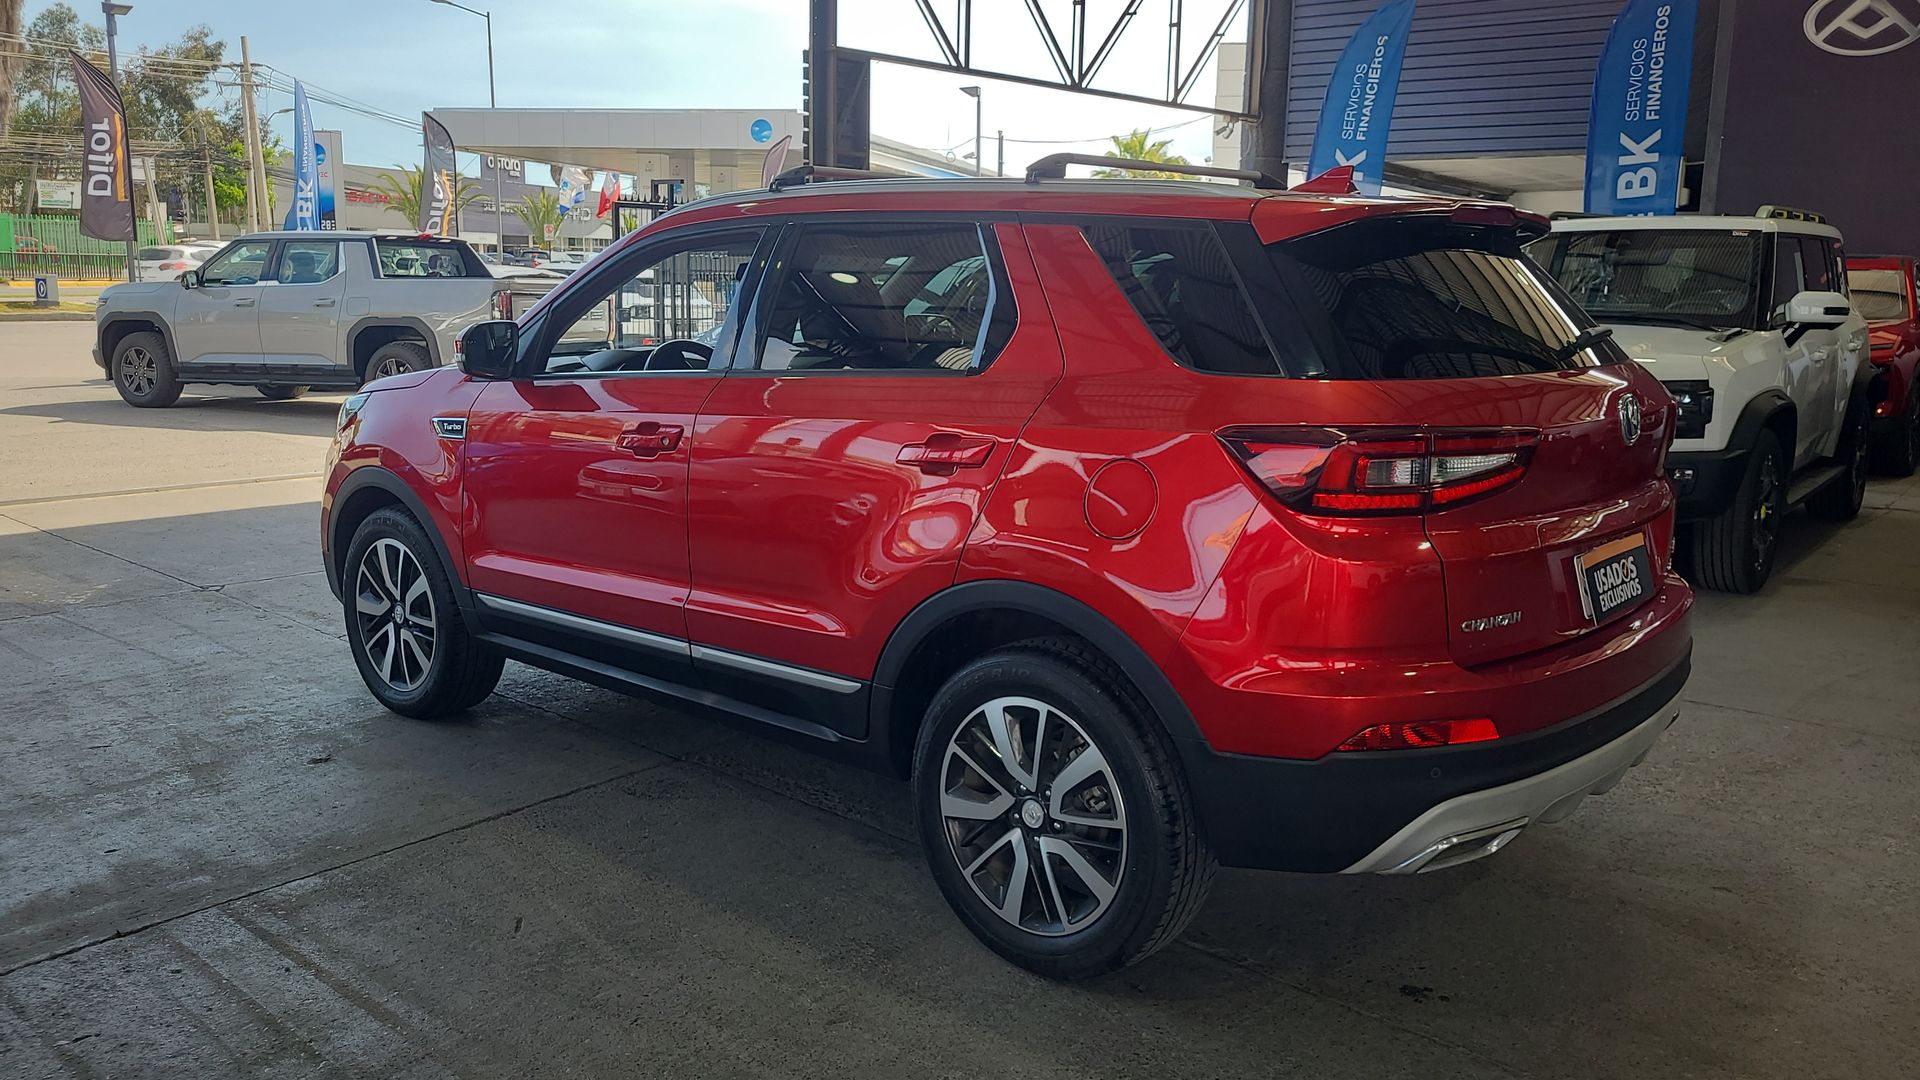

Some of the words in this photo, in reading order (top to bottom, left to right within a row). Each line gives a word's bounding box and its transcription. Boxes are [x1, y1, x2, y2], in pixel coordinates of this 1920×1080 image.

[1356, 35, 1389, 141] FINANCIEROS
[1625, 38, 1647, 121] SERVICIOS
[1646, 4, 1671, 121] FINANCIEROS
[1342, 63, 1368, 140] SERVICIOS
[1616, 128, 1662, 200] BK
[443, 422, 462, 430] Turbo
[1593, 556, 1638, 593] USADOS
[1599, 578, 1642, 612] EXCLUSIVOS
[1461, 611, 1522, 632] CHANGAN
